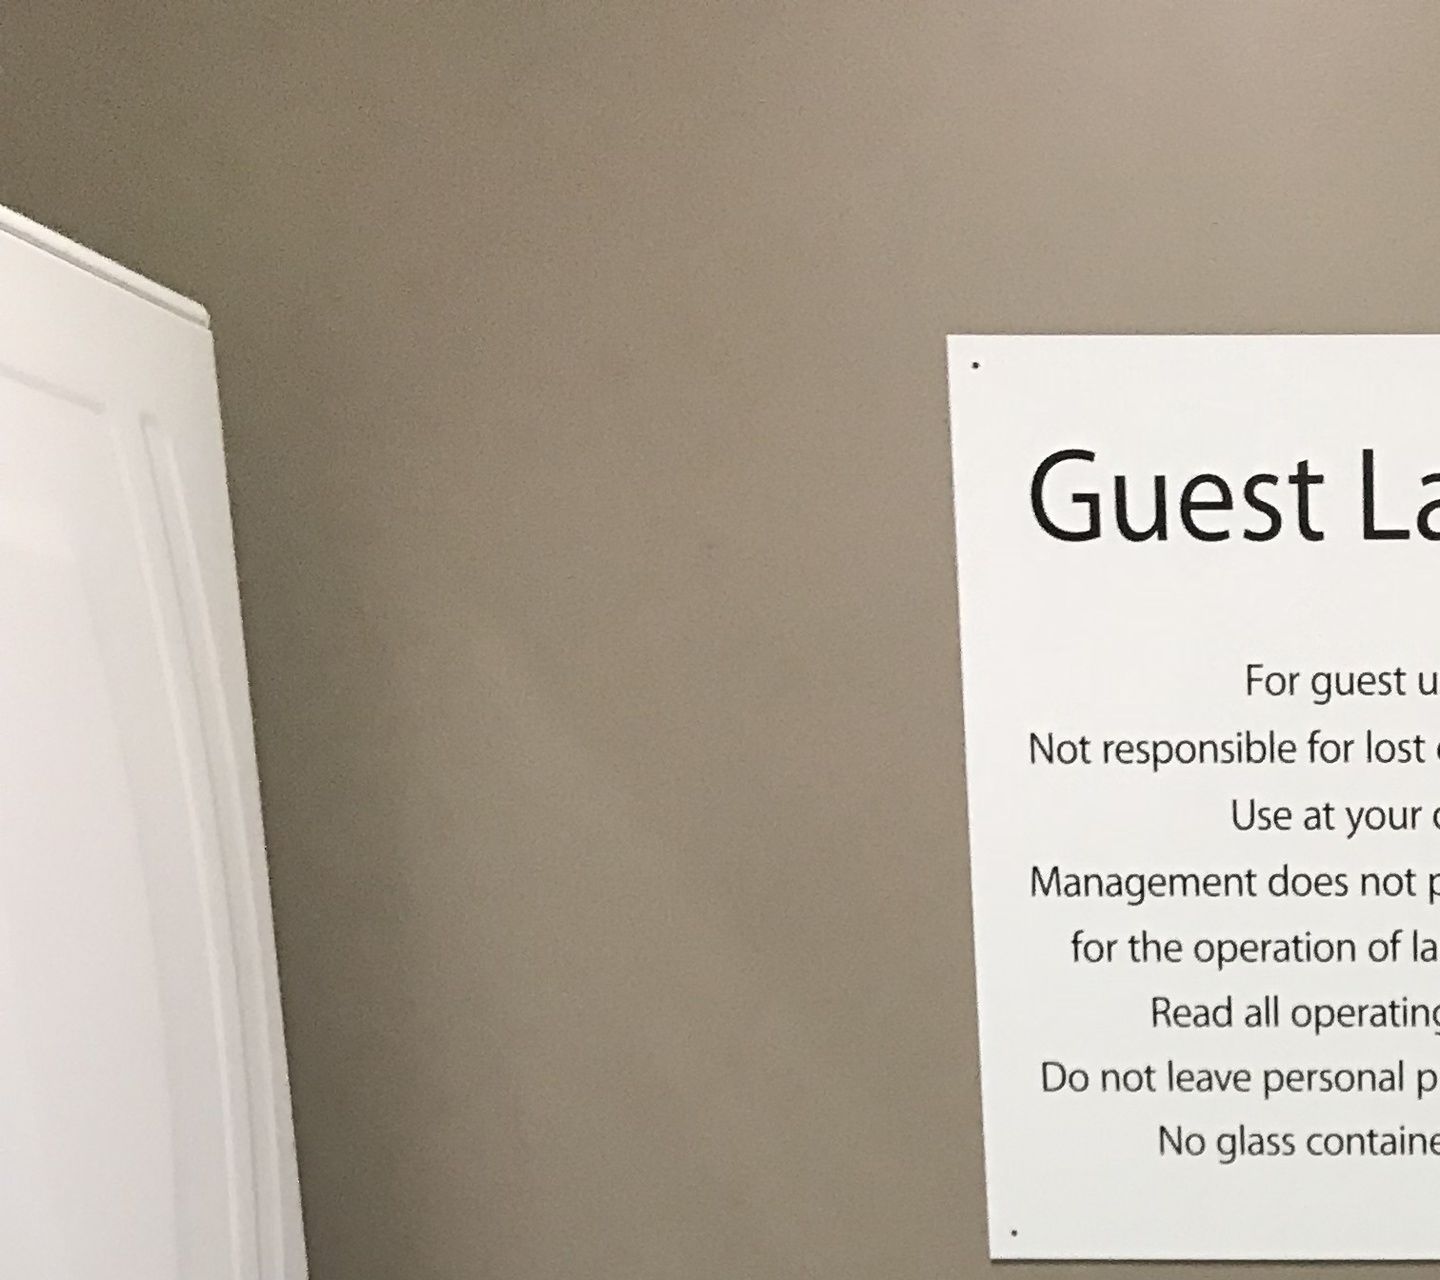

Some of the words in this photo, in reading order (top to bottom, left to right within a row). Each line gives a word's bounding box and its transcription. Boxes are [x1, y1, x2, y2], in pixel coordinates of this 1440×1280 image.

[1030, 448, 1325, 543] Guest
[1246, 663, 1300, 697] For
[1311, 667, 1407, 706] guest
[1029, 732, 1092, 765] Not
[1103, 729, 1297, 773] responsible
[1307, 729, 1355, 764] for
[1366, 729, 1426, 764] lost
[1232, 798, 1293, 831] Use
[1303, 802, 1336, 831] at
[1345, 806, 1423, 840] your
[1031, 865, 1258, 907] Management
[1268, 863, 1349, 897] does
[1361, 868, 1417, 897] not
[1070, 929, 1118, 963] for
[1127, 929, 1183, 963] the
[1193, 930, 1356, 972] operation
[1368, 928, 1403, 963] of
[1152, 994, 1233, 1028] Read
[1244, 994, 1279, 1028] all
[1041, 1061, 1090, 1093] Do
[1101, 1065, 1157, 1093] not
[1167, 1059, 1252, 1093] leave
[1263, 1059, 1404, 1100] personal
[1159, 1125, 1206, 1156] No
[1216, 1123, 1296, 1165] glass
